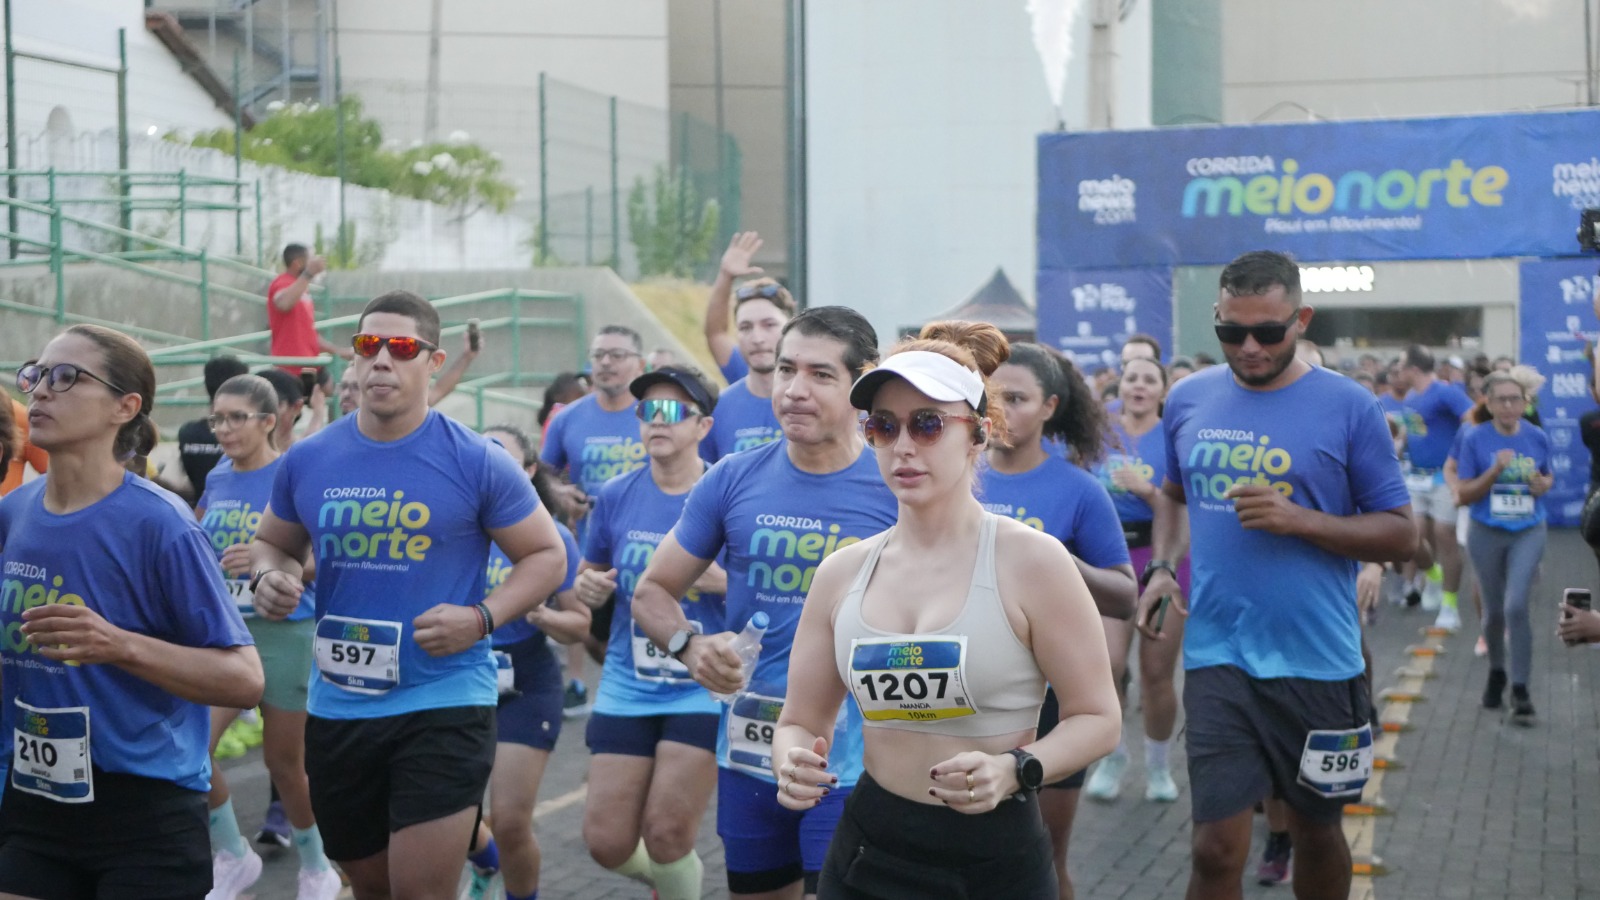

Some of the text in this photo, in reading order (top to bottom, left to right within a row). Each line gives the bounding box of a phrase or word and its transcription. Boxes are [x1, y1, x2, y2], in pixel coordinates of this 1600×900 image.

[1186, 155, 1275, 176] CORRIDA
[1553, 157, 1600, 179] mei
[1078, 174, 1136, 195] meio
[1078, 194, 1135, 211] news
[1303, 219, 1328, 232] em
[1198, 428, 1254, 442] CORRIDA
[582, 437, 646, 461] meio
[1188, 435, 1292, 475] meio
[323, 487, 387, 499] CORRIDA
[202, 503, 263, 530] meio
[318, 490, 431, 529] meio
[755, 514, 822, 530] CORRIDA
[320, 527, 432, 561] norte
[331, 643, 376, 665] 597
[888, 643, 922, 656] meio
[886, 655, 924, 667] norte
[347, 676, 364, 686] 5km
[860, 672, 949, 701] 1207
[907, 711, 937, 720] 10km
[18, 735, 58, 767] 210
[1320, 752, 1360, 772] 596
